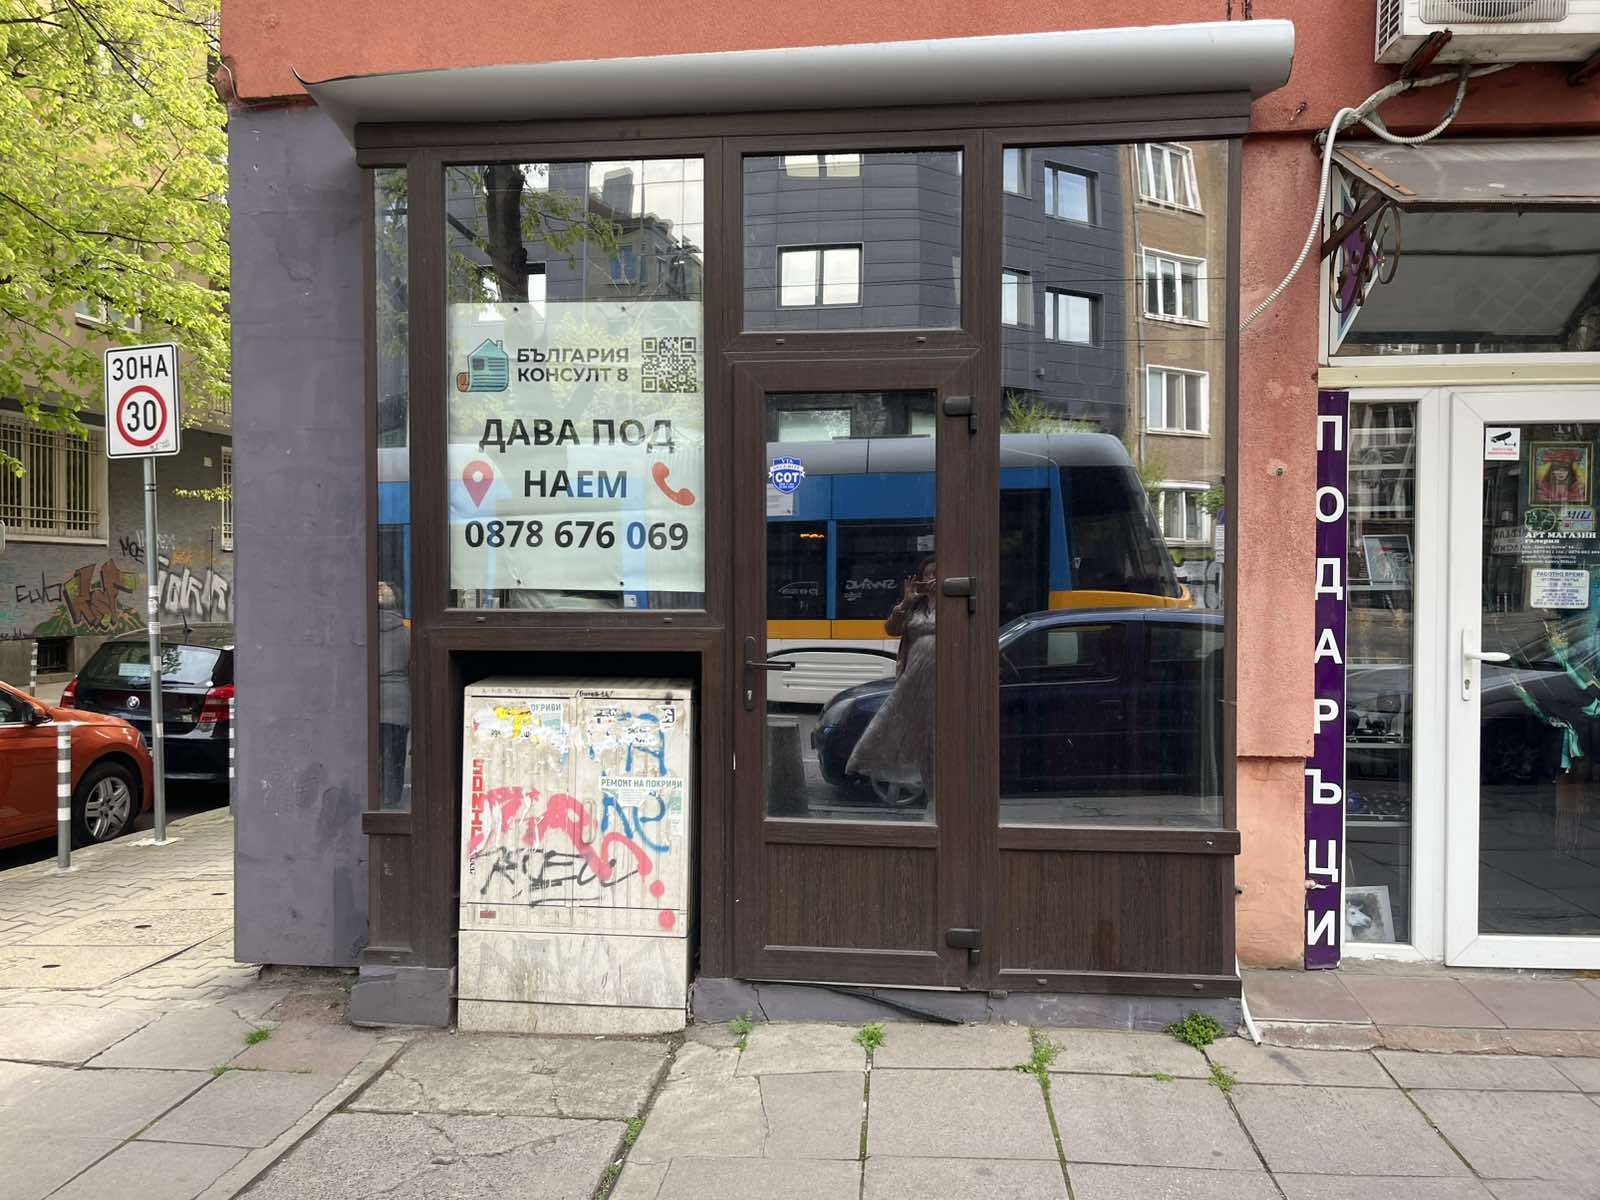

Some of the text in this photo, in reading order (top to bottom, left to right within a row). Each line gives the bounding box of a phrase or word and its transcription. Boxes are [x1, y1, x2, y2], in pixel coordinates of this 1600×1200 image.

[112, 354, 169, 381] ЗОНА
[516, 348, 630, 363] БЪЛГАРИЯ
[517, 368, 629, 383] КОНСУЛТ 8
[126, 399, 157, 432] 30
[478, 418, 675, 454] ДАВА ПОД
[523, 470, 628, 498] НАЕМ
[775, 472, 799, 483] СОТ
[464, 520, 689, 550] 0878 676 069
[1524, 531, 1546, 539] АРТ
[1547, 531, 1597, 539] МАГАЗИН
[1305, 415, 1345, 947] ПОДАРЪЦИ
[601, 778, 632, 787] РЕМОНТ
[633, 779, 645, 787] НА
